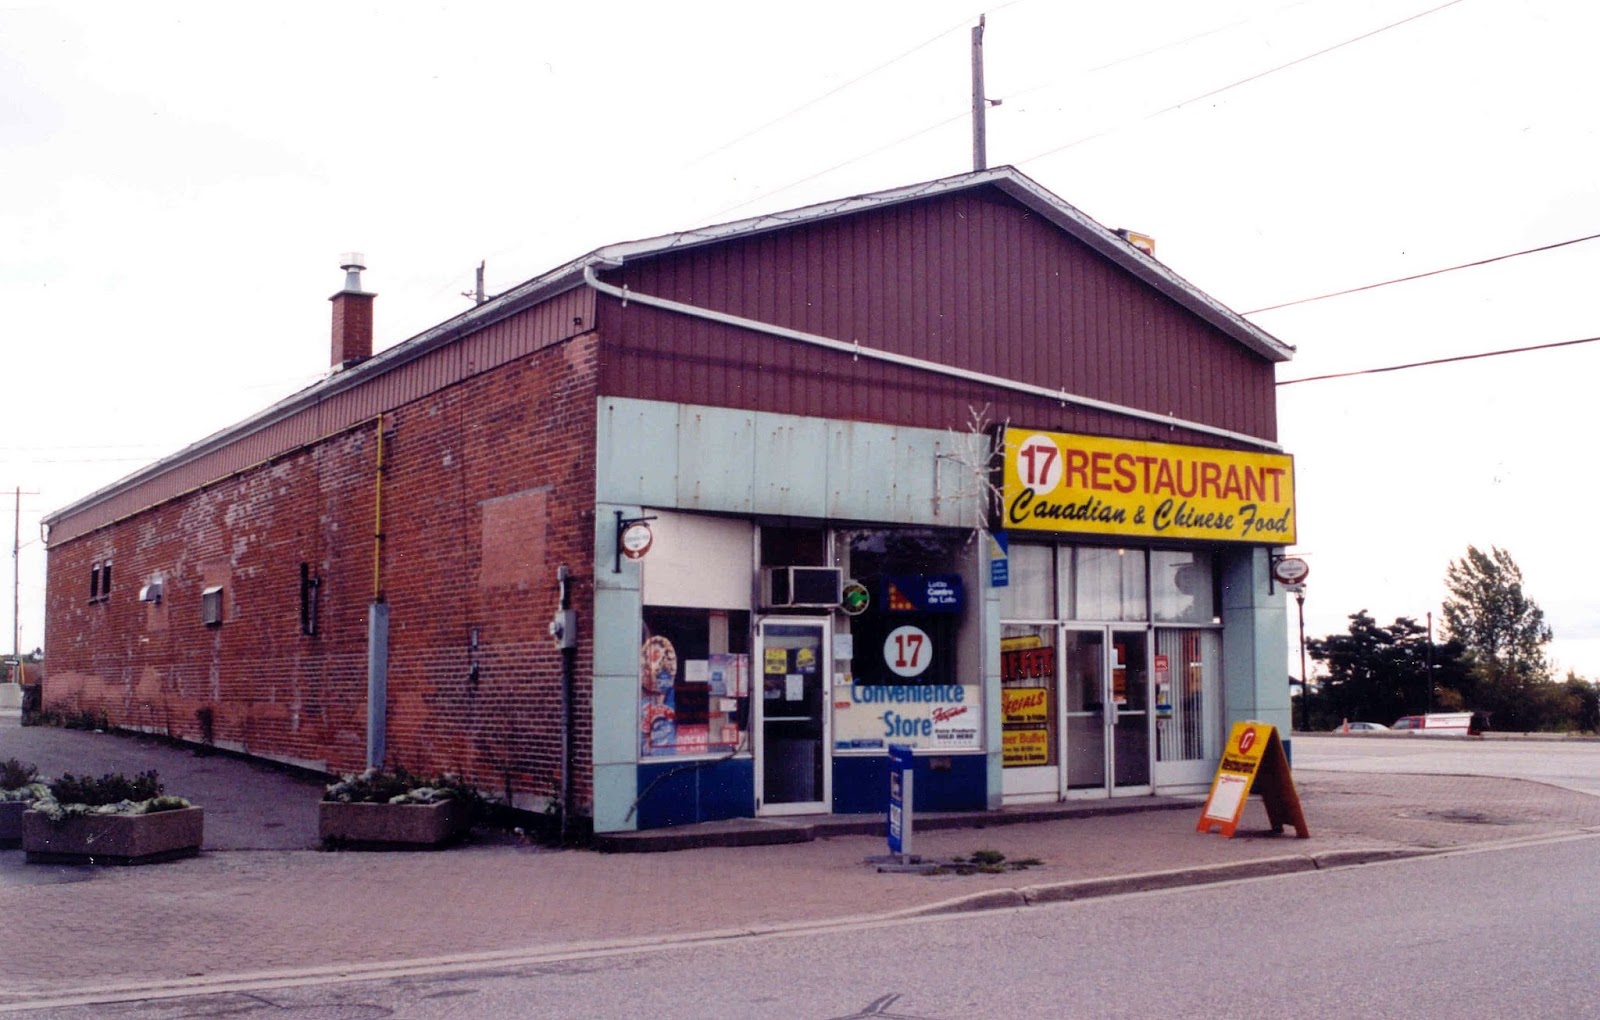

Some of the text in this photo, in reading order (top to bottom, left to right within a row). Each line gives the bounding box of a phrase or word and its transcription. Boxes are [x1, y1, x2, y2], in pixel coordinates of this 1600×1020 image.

[1021, 445, 1286, 503] 17 RESTAURANT
[1009, 487, 1291, 536] Canadian & Chinese Food
[895, 634, 923, 668] 17
[851, 679, 965, 704] Convenience
[884, 710, 932, 737] Store
